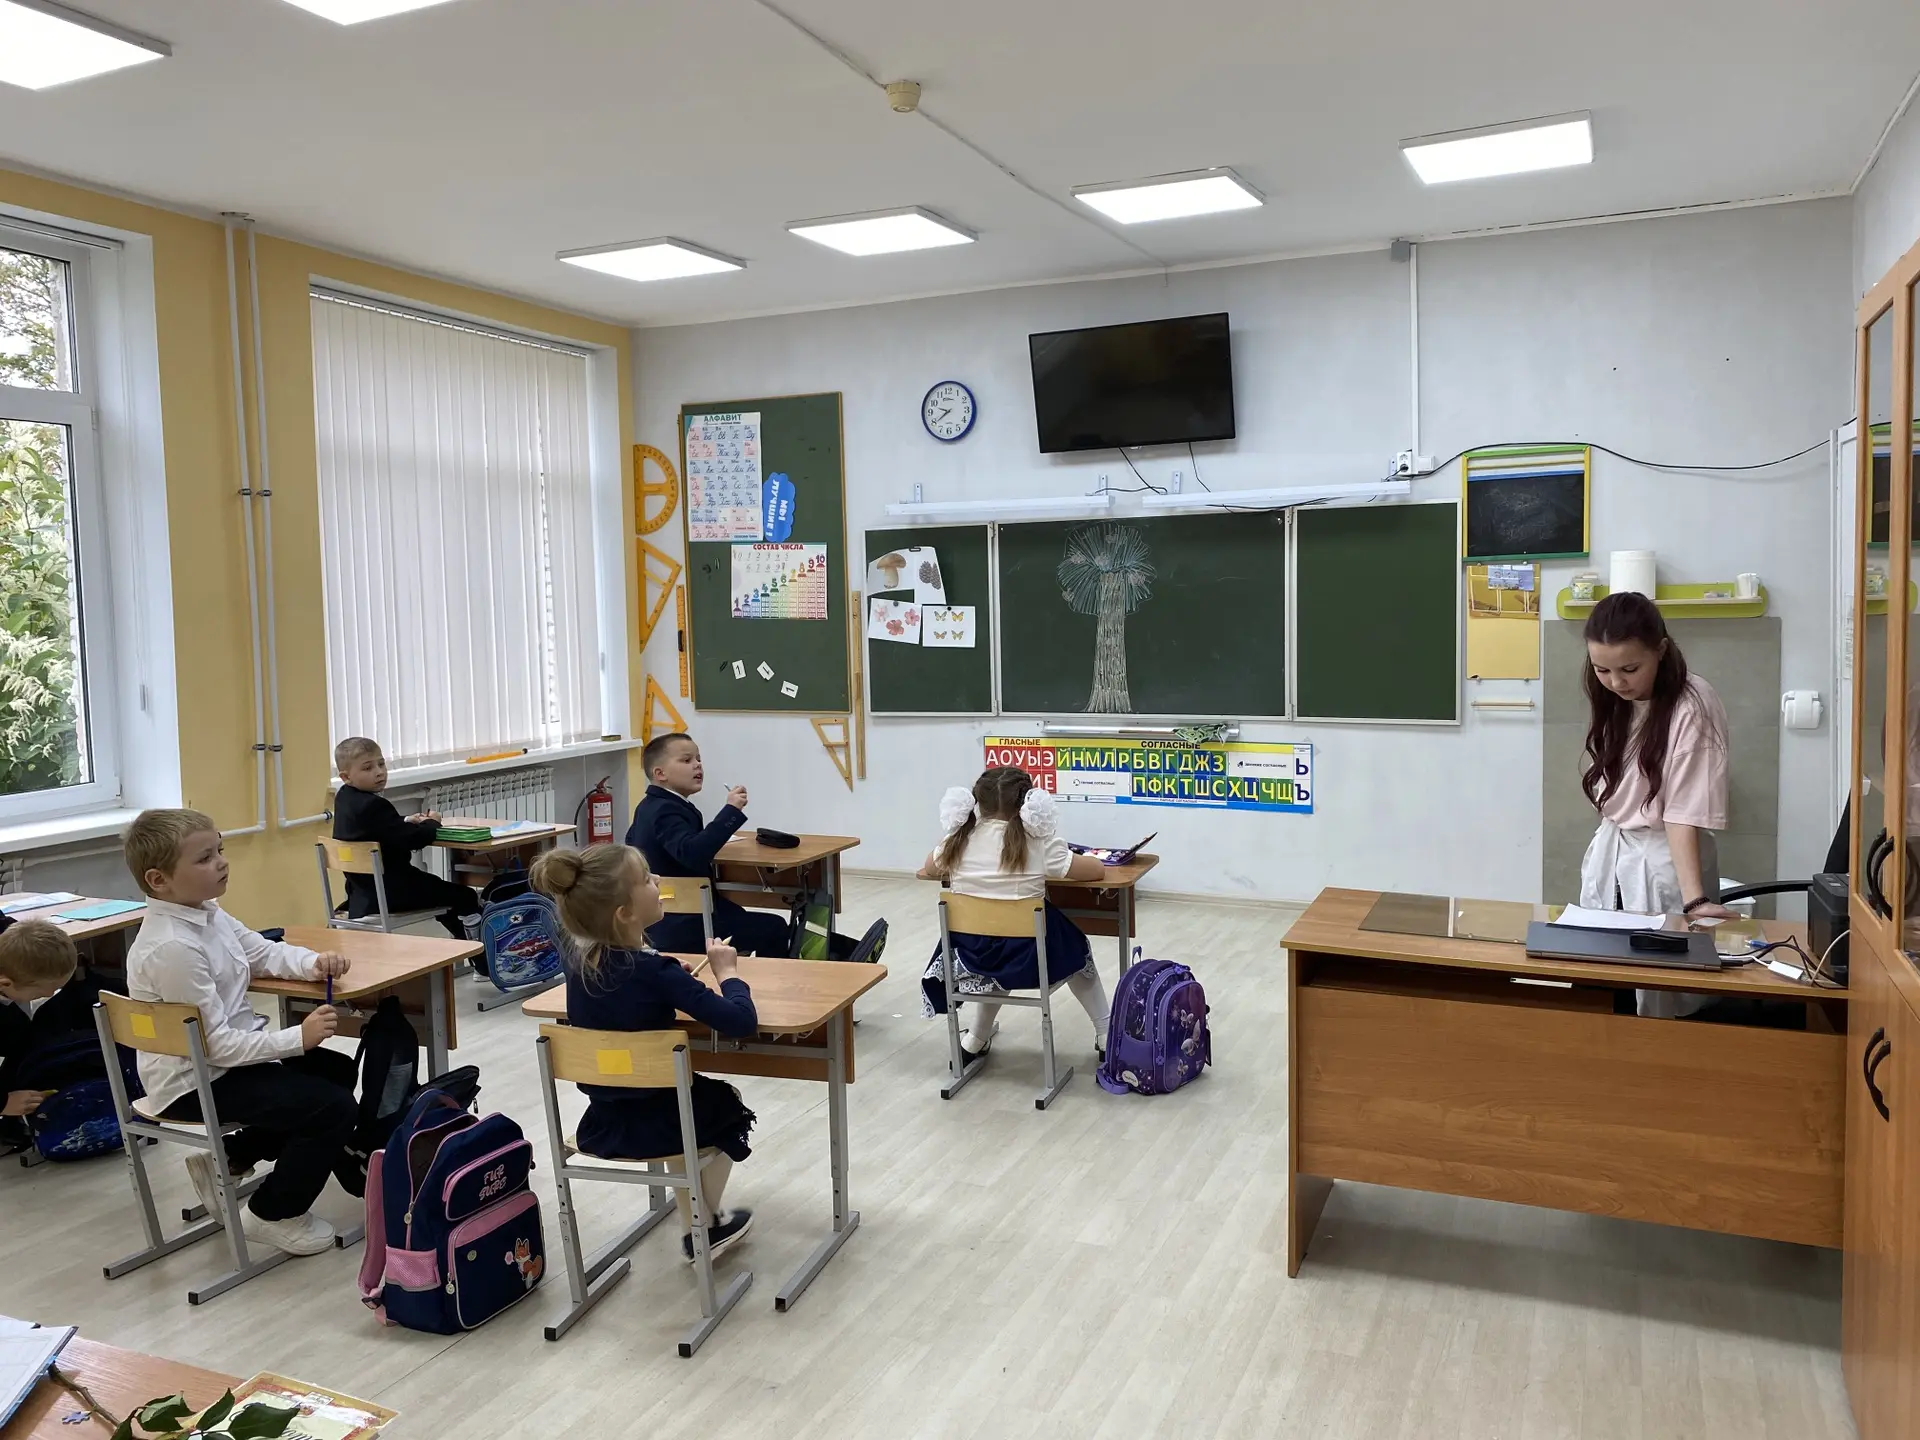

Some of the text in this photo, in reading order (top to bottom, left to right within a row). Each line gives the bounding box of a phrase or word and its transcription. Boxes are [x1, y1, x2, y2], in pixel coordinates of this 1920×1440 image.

[704, 414, 742, 422] АЛФАВИТ
[778, 500, 788, 521] МЫ
[999, 738, 1041, 746] ГЛАСНЫЕ
[1141, 740, 1201, 749] СОГЛАСНЫЕ
[484, 1164, 504, 1184] FUR
